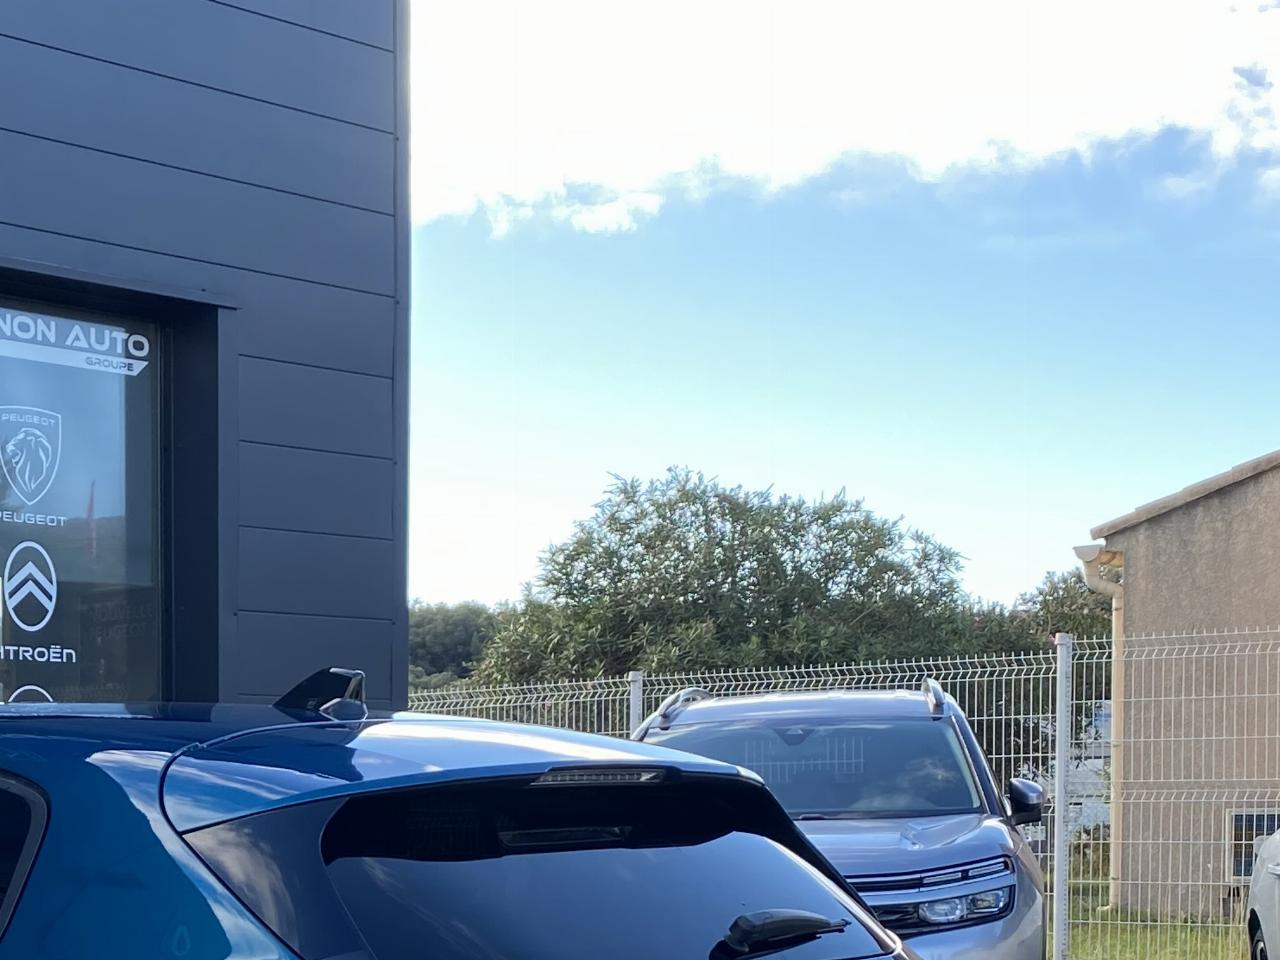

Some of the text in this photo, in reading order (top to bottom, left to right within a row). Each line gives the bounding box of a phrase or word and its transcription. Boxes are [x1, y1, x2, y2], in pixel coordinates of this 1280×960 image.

[65, 324, 150, 357] AUTO
[85, 356, 135, 372] GROUPE
[1, 413, 56, 426] PEUGEOT
